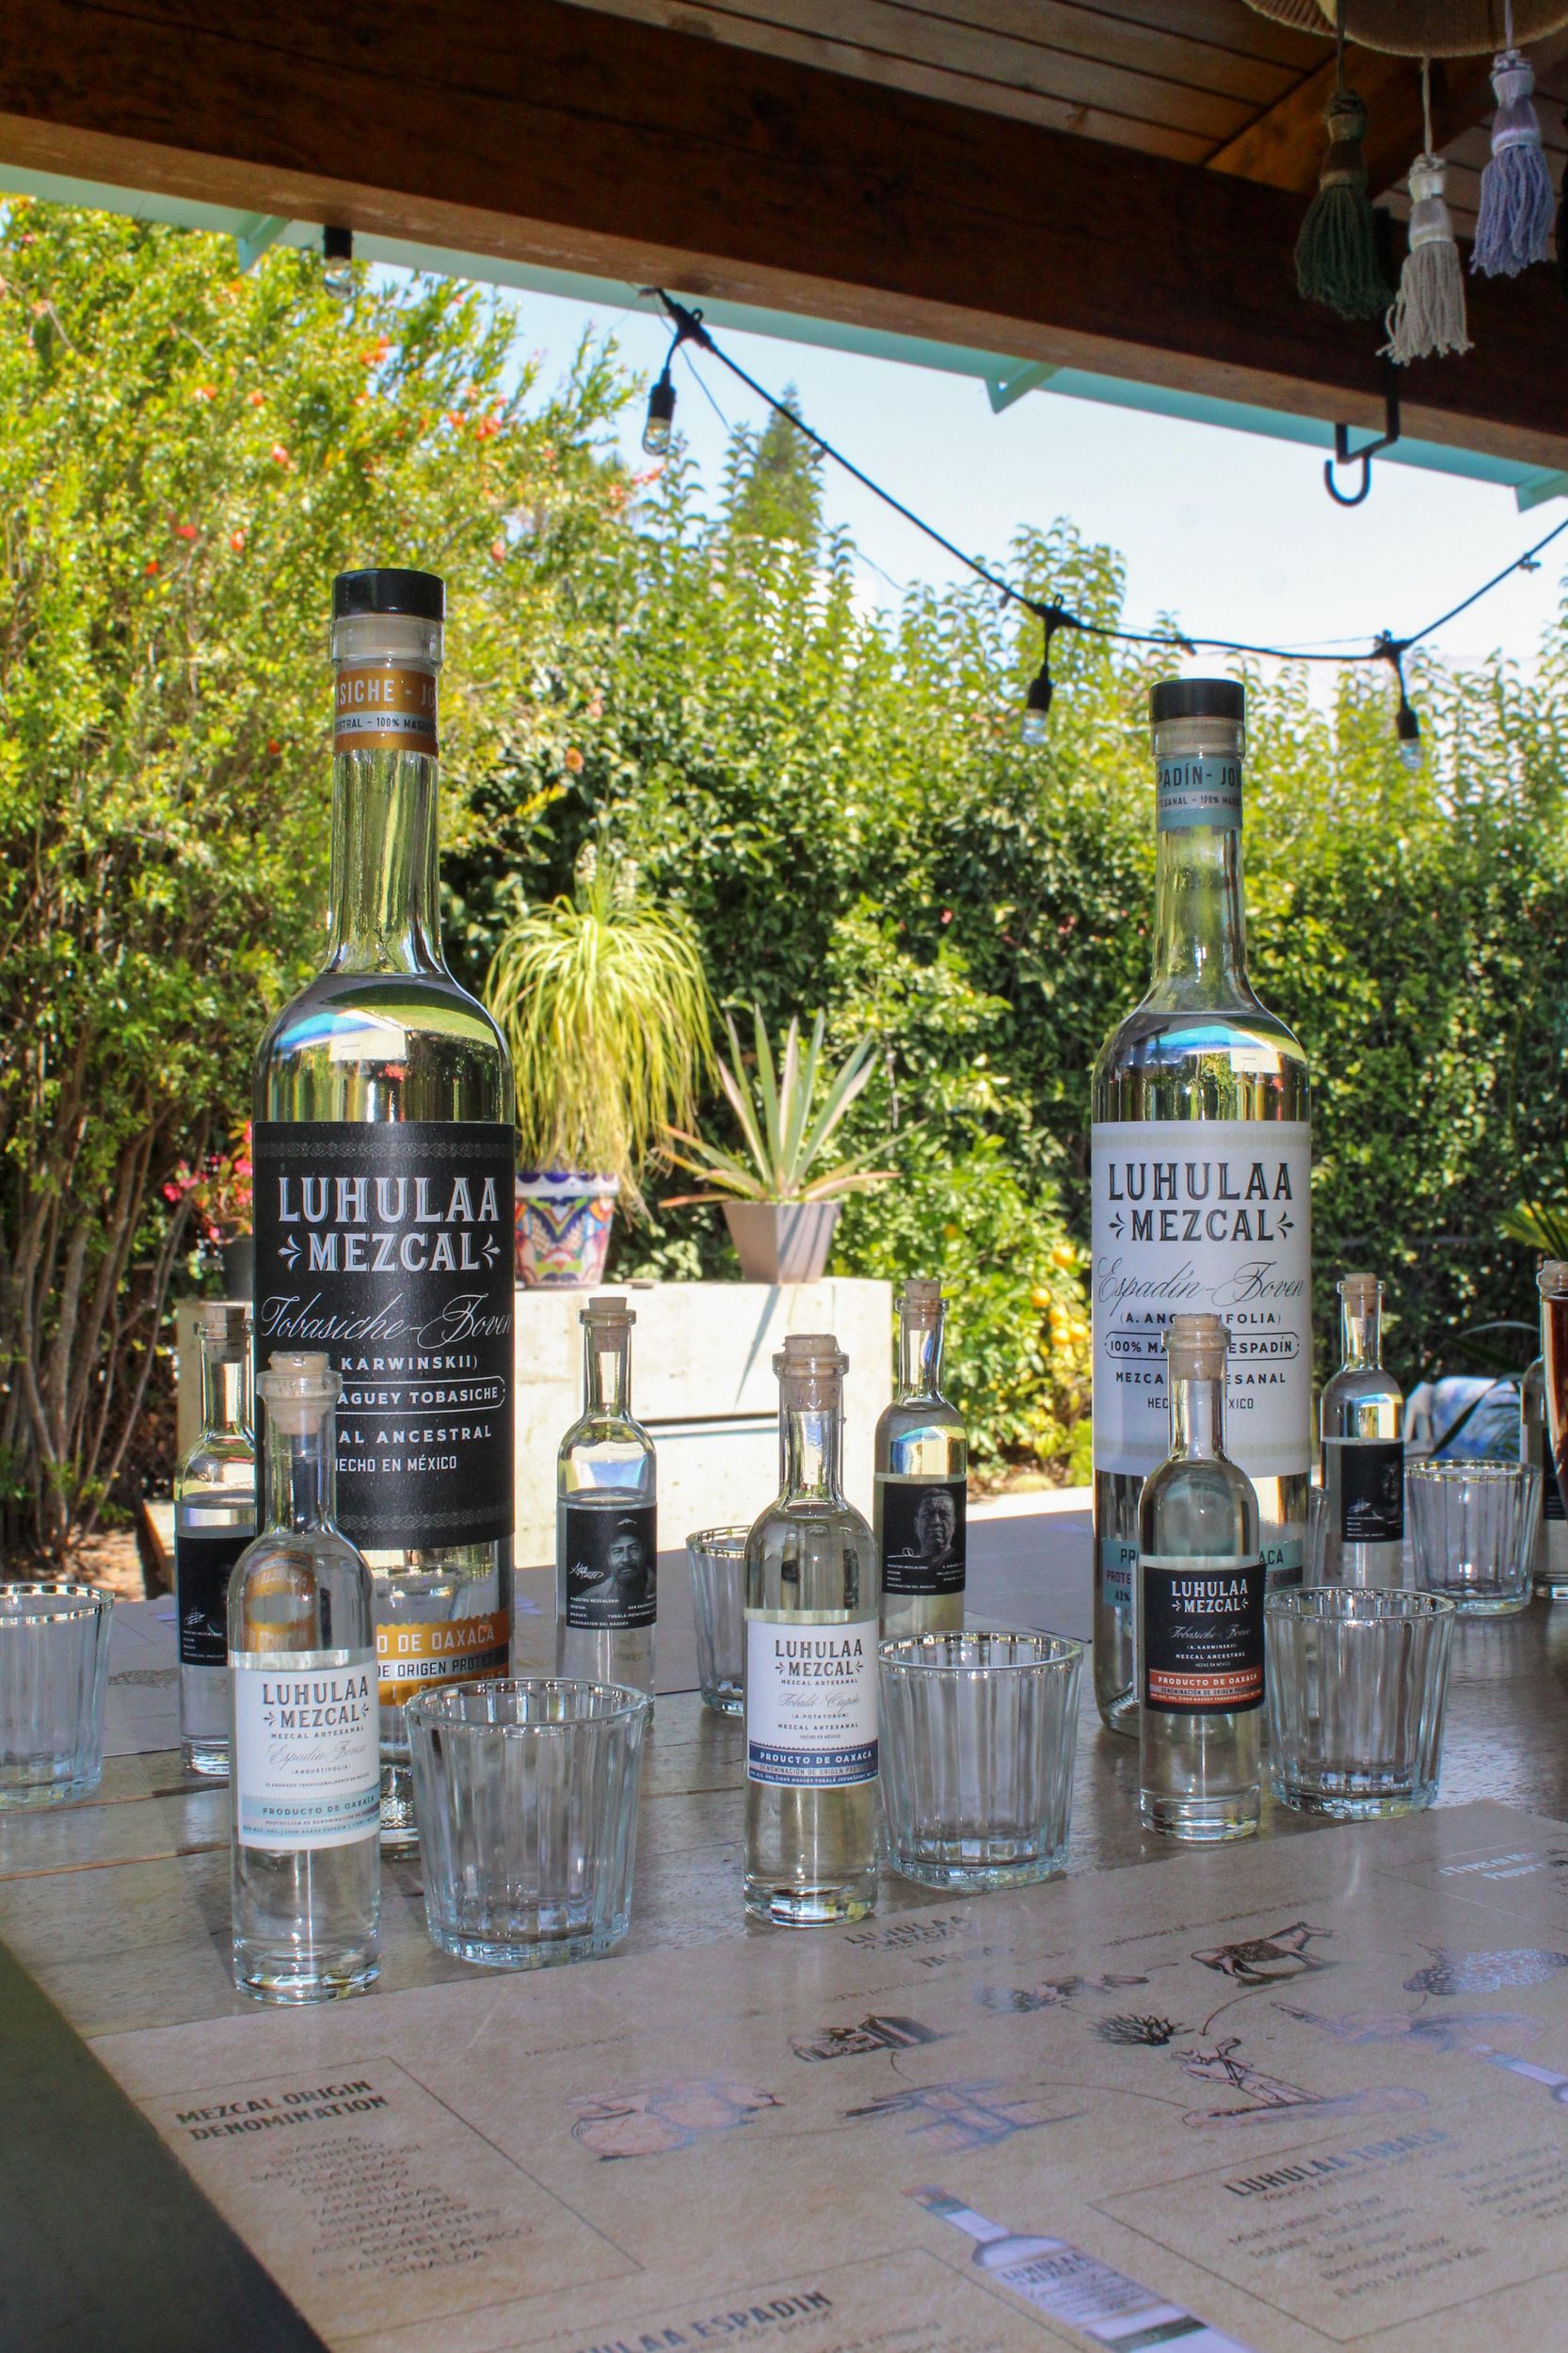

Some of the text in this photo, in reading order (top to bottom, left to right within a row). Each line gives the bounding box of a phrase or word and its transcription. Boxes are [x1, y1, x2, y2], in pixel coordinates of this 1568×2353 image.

[336, 679, 394, 706] SICHE
[376, 717, 400, 728] 100%
[1108, 1162, 1293, 1201] LUHULAA
[278, 1176, 500, 1223] LUHULAA
[1130, 1209, 1274, 1242] MEZCAL
[308, 1232, 481, 1272] MEZCAL
[1110, 1340, 1142, 1353] 100%
[1115, 1372, 1286, 1385] MEZCA ESANAL
[337, 1386, 498, 1405] AGUEY TOBASICHE
[1148, 1398, 1255, 1409] HEC XICO
[376, 1425, 491, 1444] ANCESTRAL
[382, 1458, 402, 1472] EN
[408, 1454, 457, 1471] MÉXICO
[1259, 1548, 1284, 1565] ACA
[1171, 1578, 1249, 1598] LUHULAA
[1184, 1598, 1242, 1613] MEZCAL
[397, 1633, 423, 1653] DE
[431, 1625, 494, 1651] OAXACA
[775, 1639, 863, 1659] LUHULAA
[1207, 1651, 1246, 1659] ANCESTRAL
[397, 1661, 447, 1677] ORIGEN
[789, 1661, 854, 1677] MEZCAL
[1158, 1676, 1209, 1686] PRODUCTO
[1228, 1673, 1257, 1685] OAXACA
[263, 1675, 369, 1705] LUHULAA
[280, 1704, 360, 1728] MEZCAL
[313, 1725, 364, 1738] ARTESANAL
[760, 1752, 810, 1765] PROUCTO
[835, 1750, 872, 1764] OAXACA
[344, 1795, 375, 1810] OAXACA
[176, 2080, 373, 2124] MEZCAL ORIGIN
[189, 2095, 390, 2141] DENOMINATION
